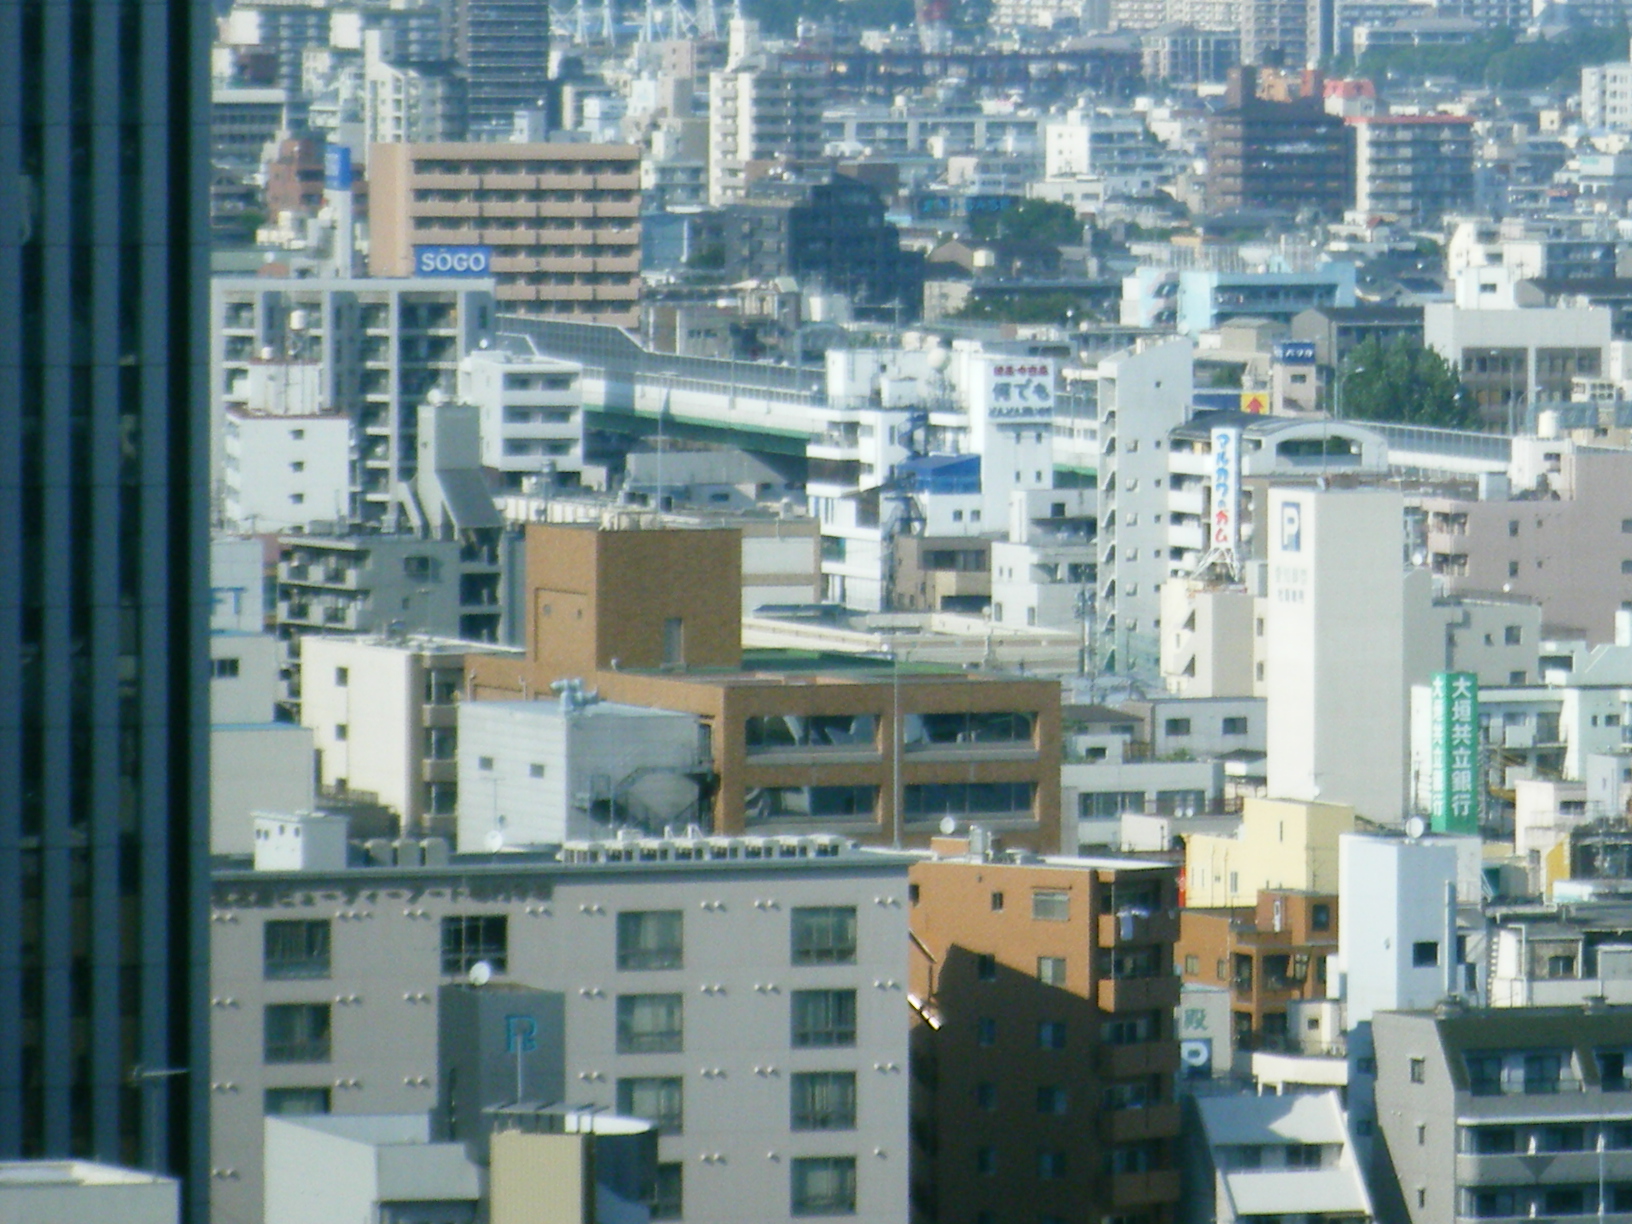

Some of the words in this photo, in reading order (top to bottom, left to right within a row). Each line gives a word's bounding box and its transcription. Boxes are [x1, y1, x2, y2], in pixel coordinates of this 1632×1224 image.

[1282, 506, 1300, 548] P
[1451, 675, 1473, 818] 大垣共立銀行
